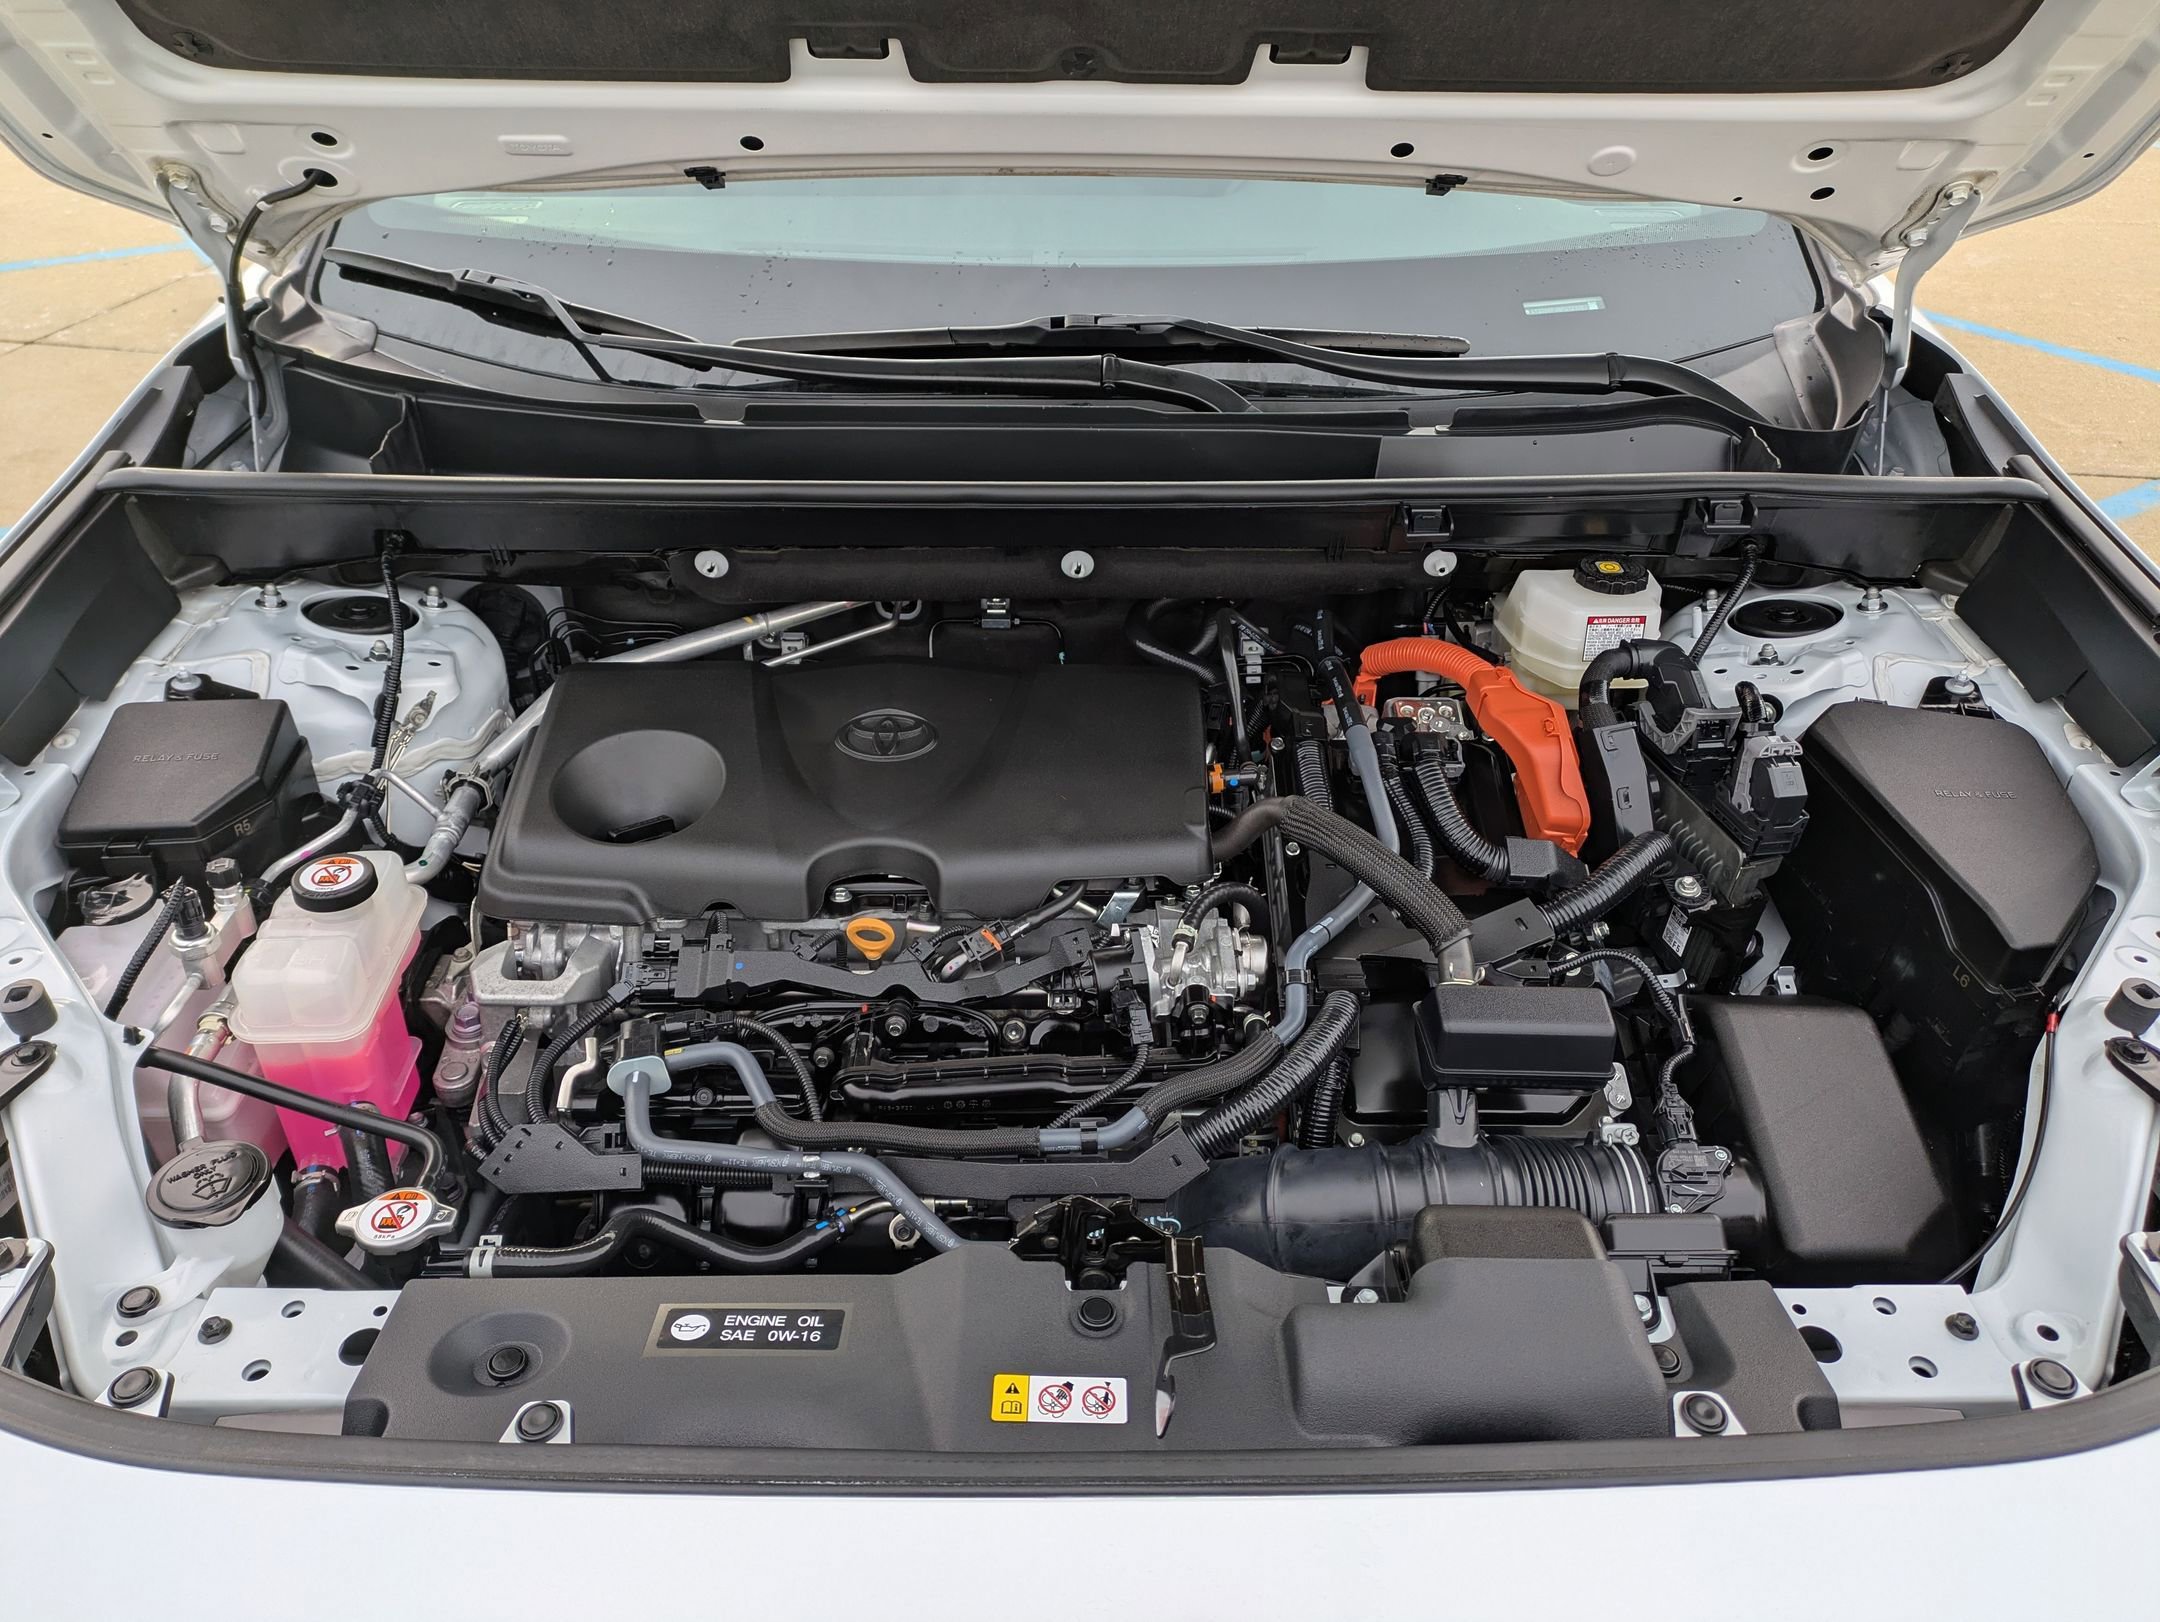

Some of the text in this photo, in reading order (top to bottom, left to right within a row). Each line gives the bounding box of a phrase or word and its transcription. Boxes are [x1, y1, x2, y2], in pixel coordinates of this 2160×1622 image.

[132, 753, 175, 763] RELAY
[186, 752, 220, 761] FUSE
[1934, 789, 1971, 799] RELAY
[1984, 791, 2017, 799] FUSE
[233, 818, 253, 838] R5
[1672, 940, 1681, 953] F5
[1952, 964, 1970, 988] L6
[166, 1150, 238, 1184] WASHER FLUID
[193, 1165, 217, 1180] ONLY
[723, 1315, 825, 1328] ENGINE OIL
[719, 1329, 822, 1342] SAE 0W-16
